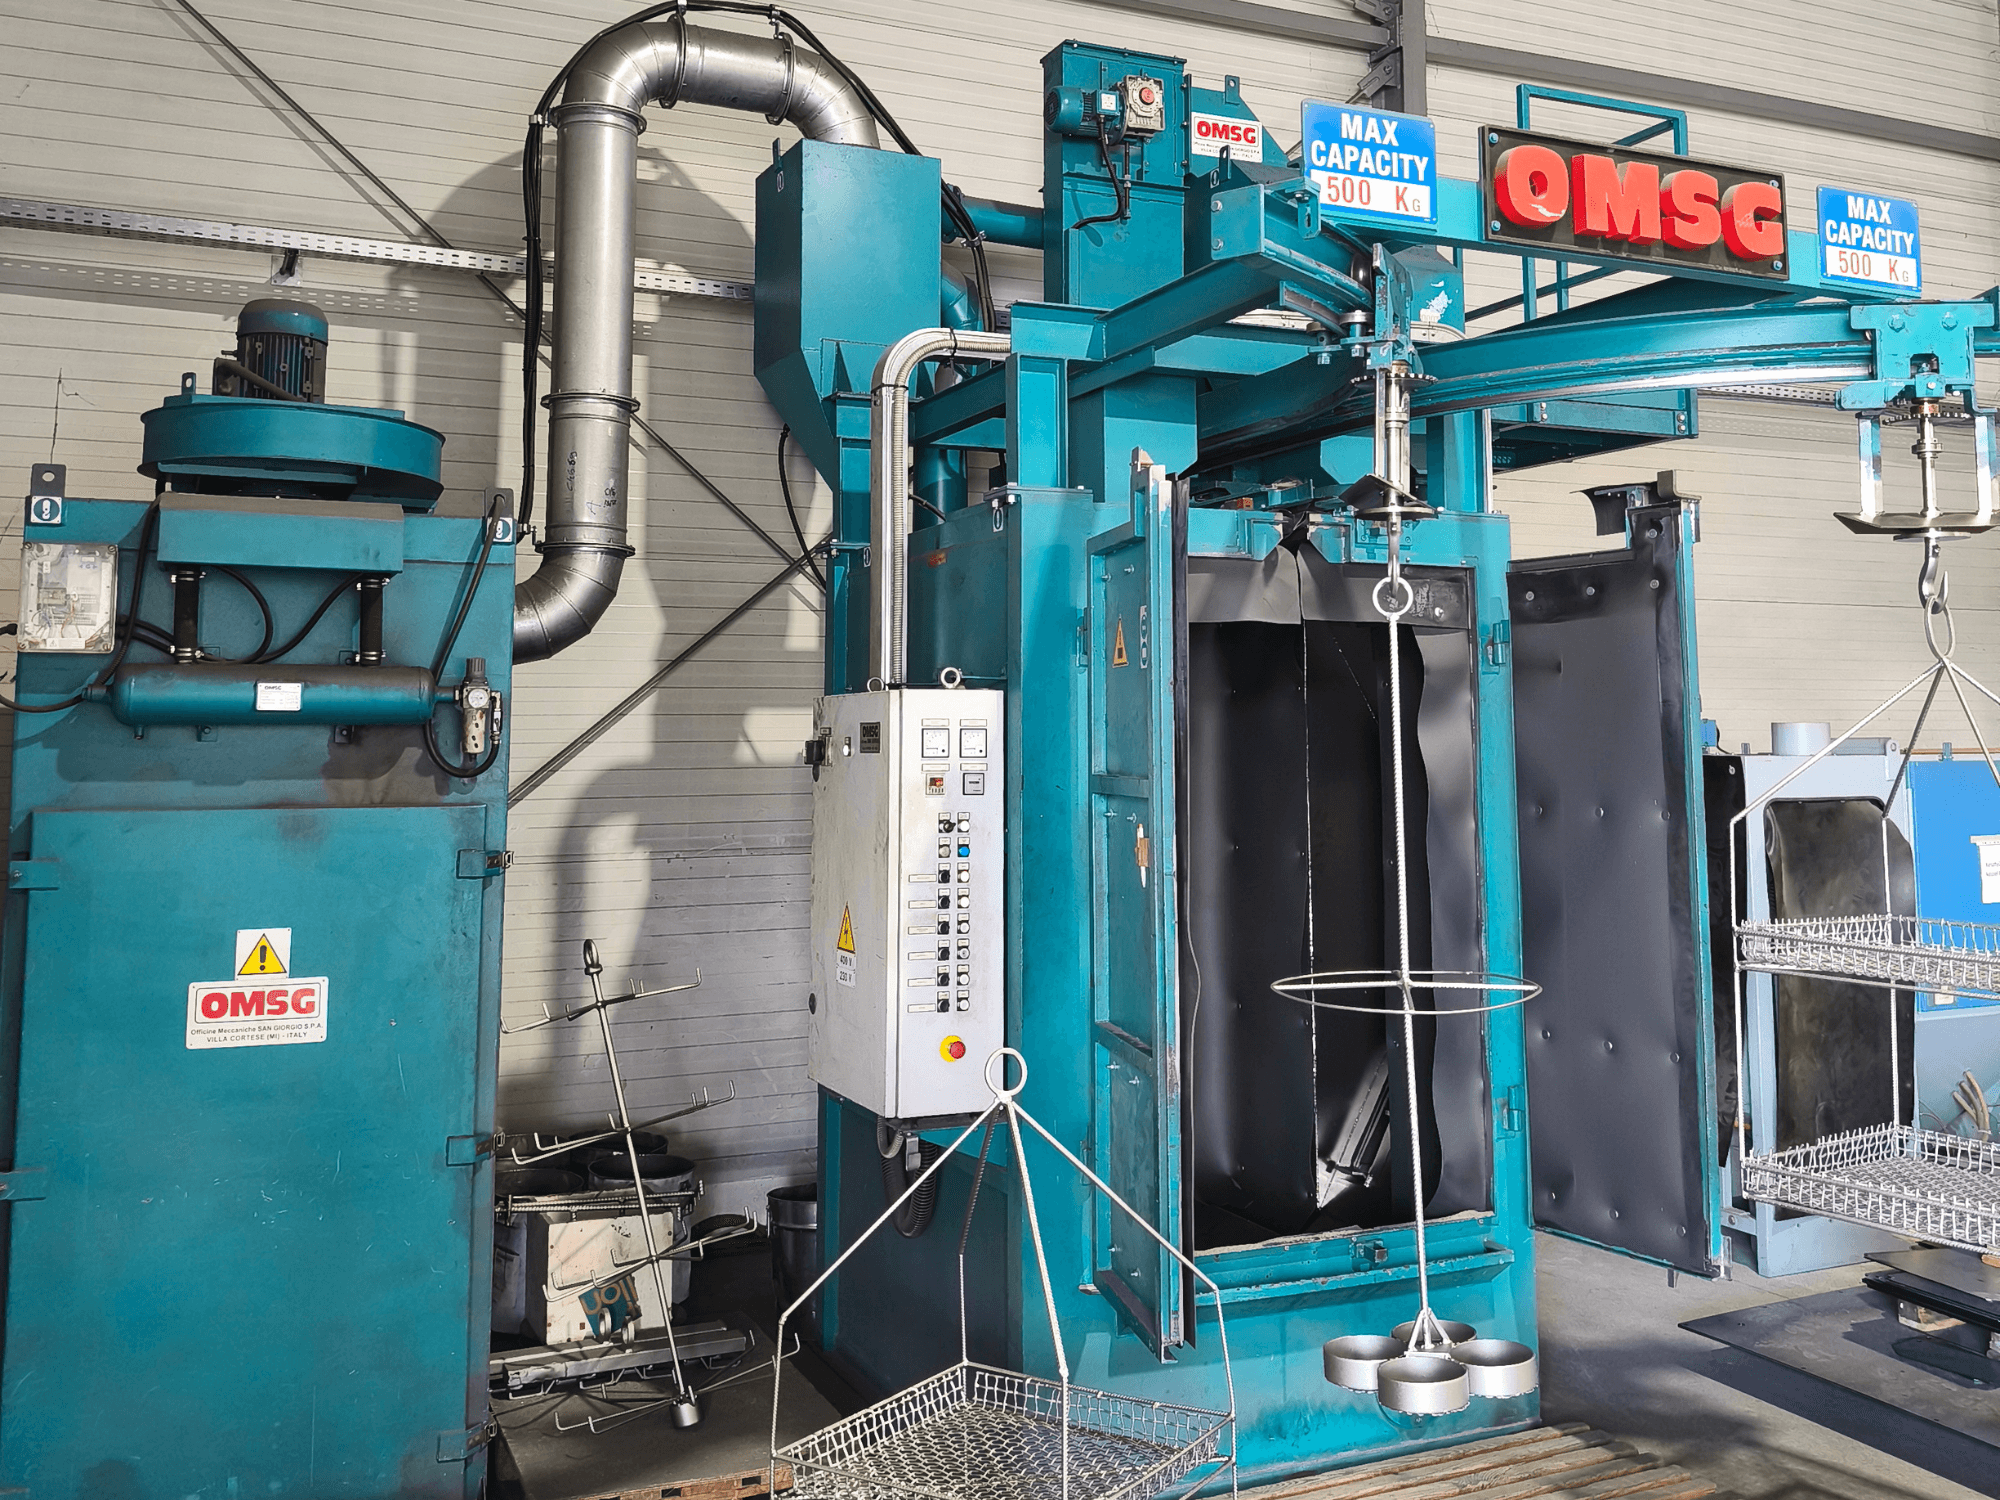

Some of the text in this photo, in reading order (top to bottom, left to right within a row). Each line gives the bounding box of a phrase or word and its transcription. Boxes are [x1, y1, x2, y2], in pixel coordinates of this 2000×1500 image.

[1197, 120, 1256, 144] OMSG
[1341, 112, 1399, 146] MAX
[1311, 139, 1429, 182] CAPACITY
[1327, 176, 1371, 205] 500
[1494, 145, 1785, 261] OMSG
[1847, 195, 1892, 225] MAX
[1825, 219, 1914, 255] CAPACITY
[1839, 250, 1871, 277] 500
[201, 988, 315, 1019] OMSG
[190, 1028, 217, 1036] Officine
[273, 1023, 303, 1031] GIORGIO
[230, 1034, 265, 1042] CORTESE
[266, 1033, 280, 1041] (MI)
